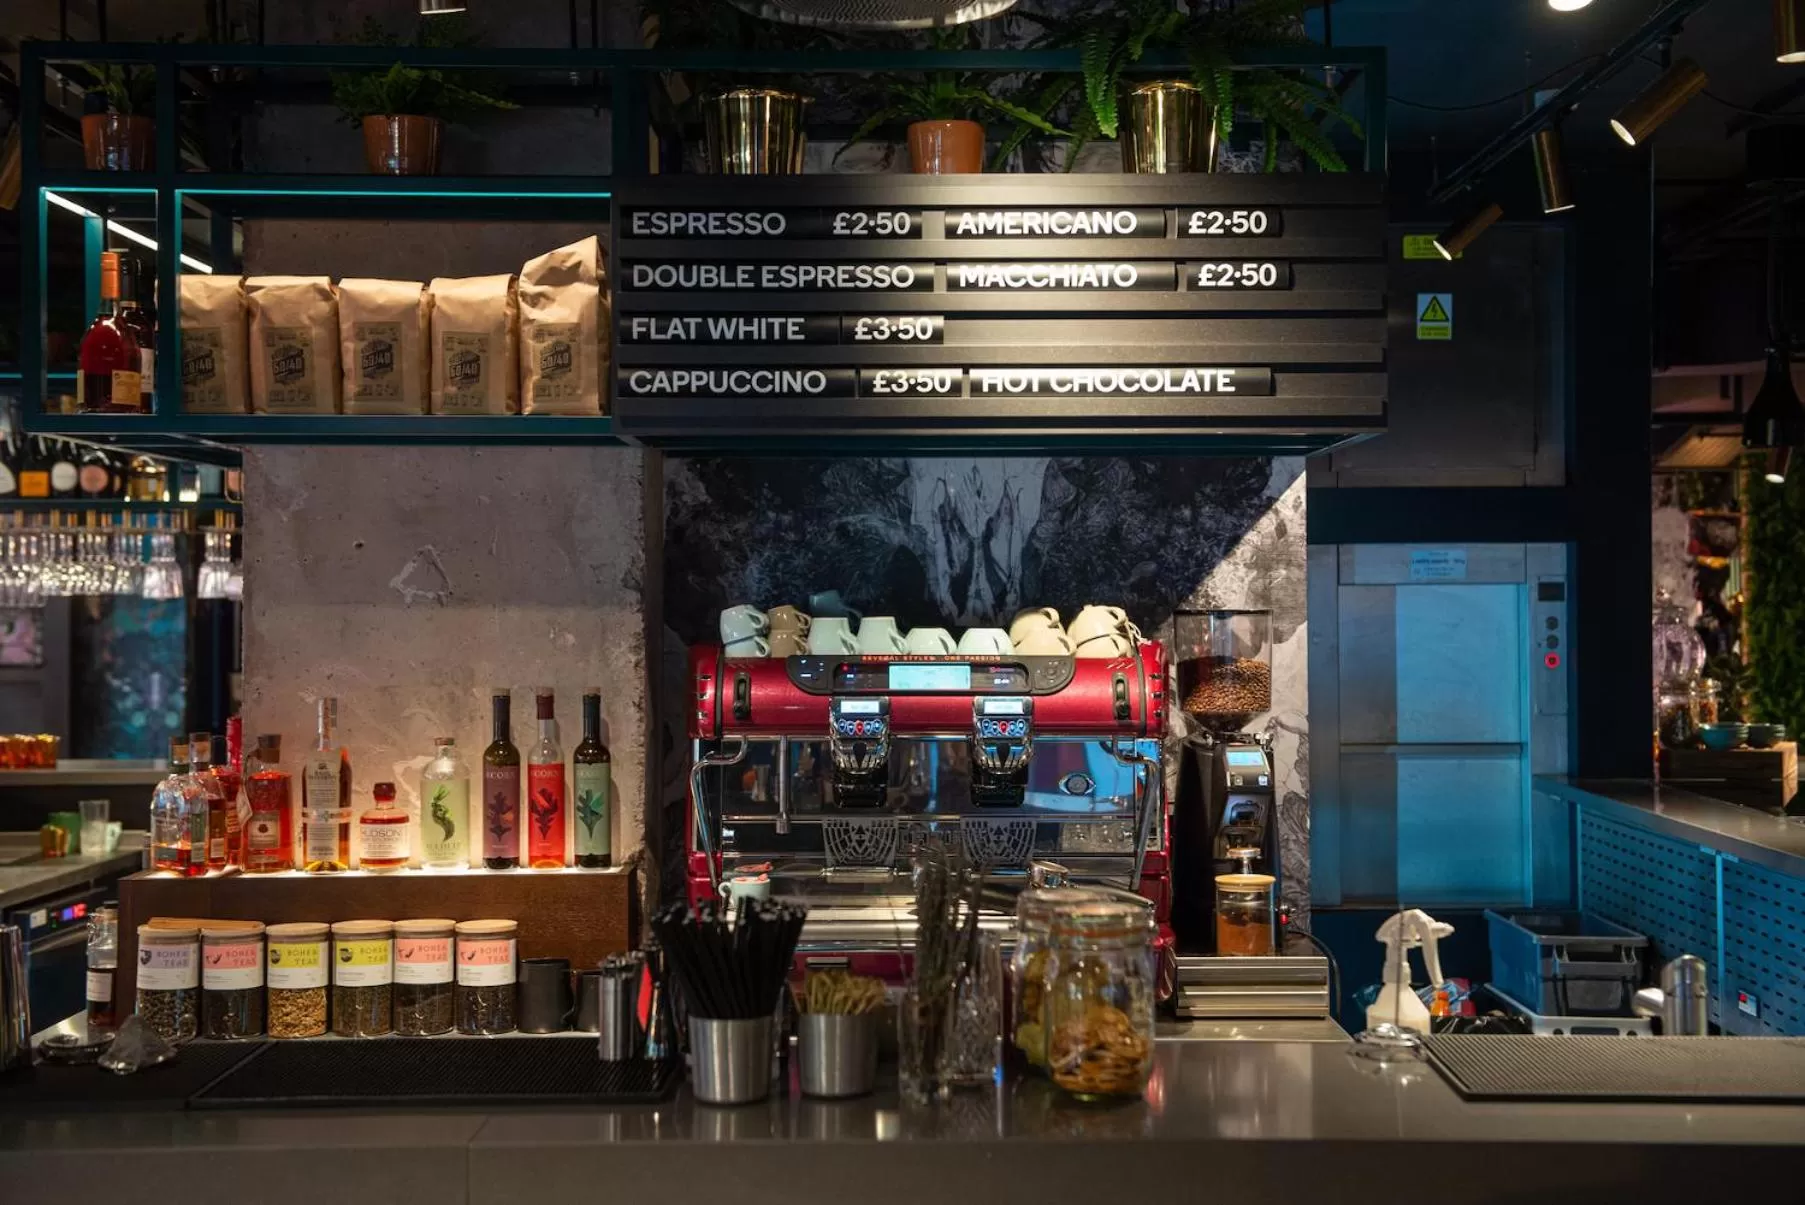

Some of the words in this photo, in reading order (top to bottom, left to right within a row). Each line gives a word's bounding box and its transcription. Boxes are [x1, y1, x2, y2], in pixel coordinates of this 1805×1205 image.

[632, 211, 787, 236] ESPRESSO
[956, 210, 1138, 235] AMERICANO
[632, 264, 755, 289] DOUBLE
[761, 264, 915, 289] ESPRESSO
[958, 263, 1138, 288] MACCHIATO
[631, 317, 703, 341] FLAT
[706, 317, 806, 341] WHITE
[629, 370, 827, 394] CAPPUCCINO
[981, 369, 1043, 393] HOT
[1049, 369, 1236, 393] CHOCOLATE
